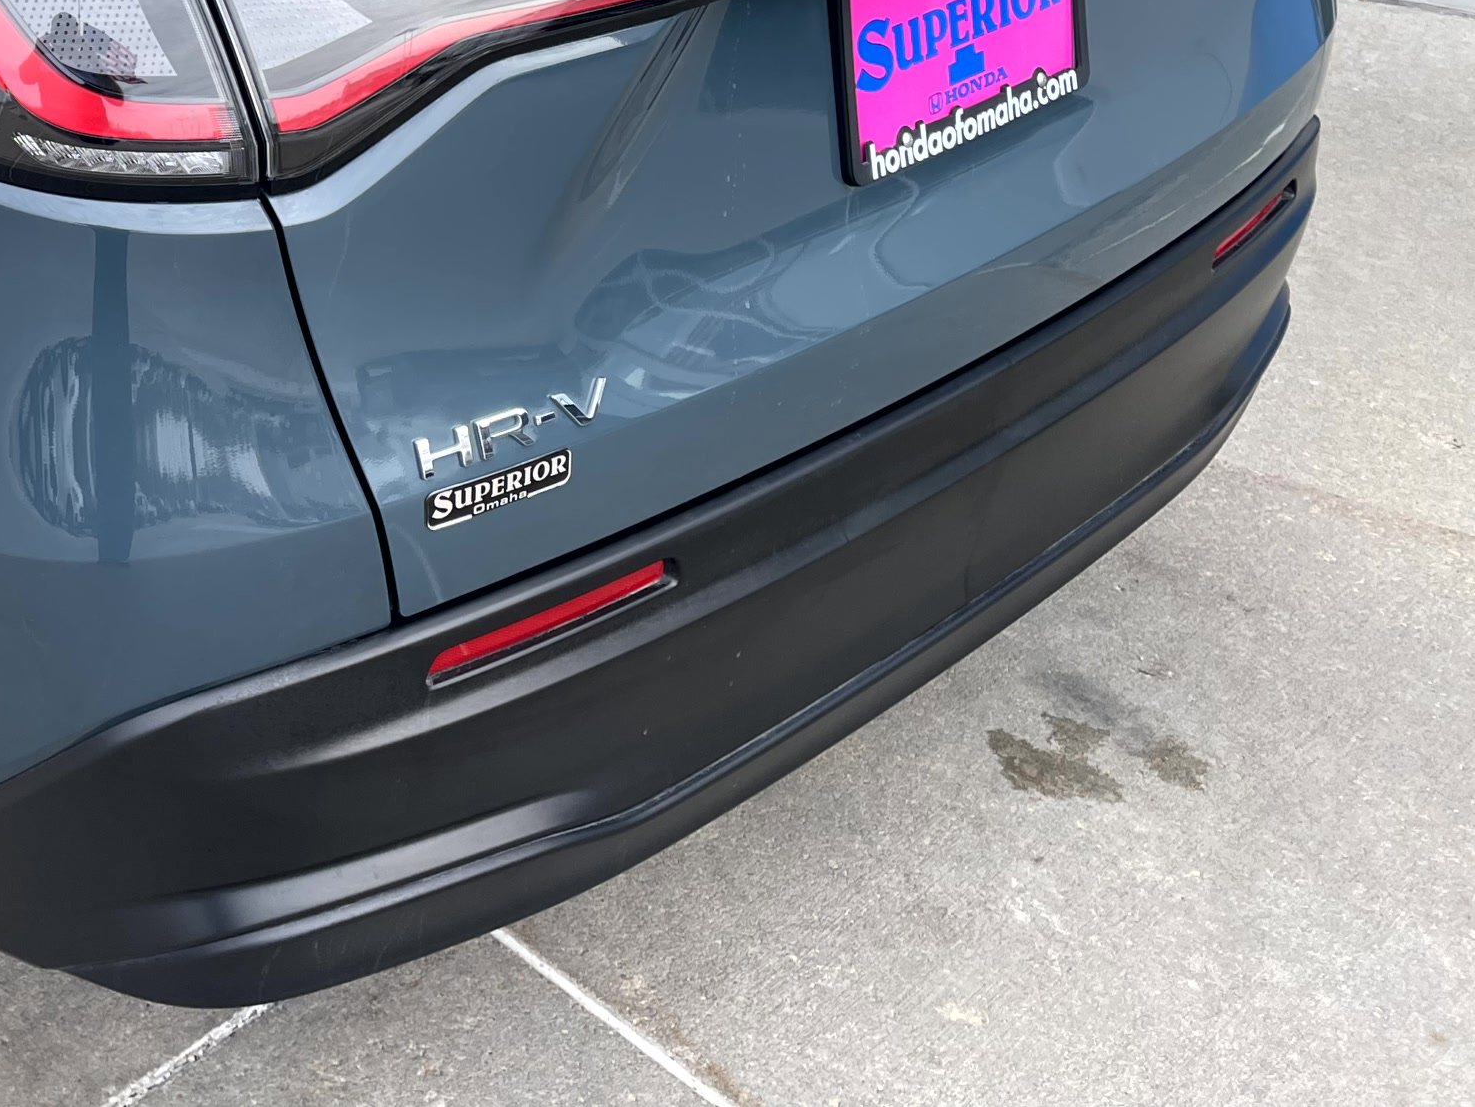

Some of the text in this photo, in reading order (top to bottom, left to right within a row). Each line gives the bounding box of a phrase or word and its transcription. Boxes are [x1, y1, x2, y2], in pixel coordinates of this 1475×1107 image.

[945, 67, 1009, 105] HONDA
[869, 69, 1079, 181] hondaofomaha.com
[412, 376, 607, 481] HR-V
[431, 453, 567, 520] SUPERIOR
[472, 490, 528, 515] Omaha
